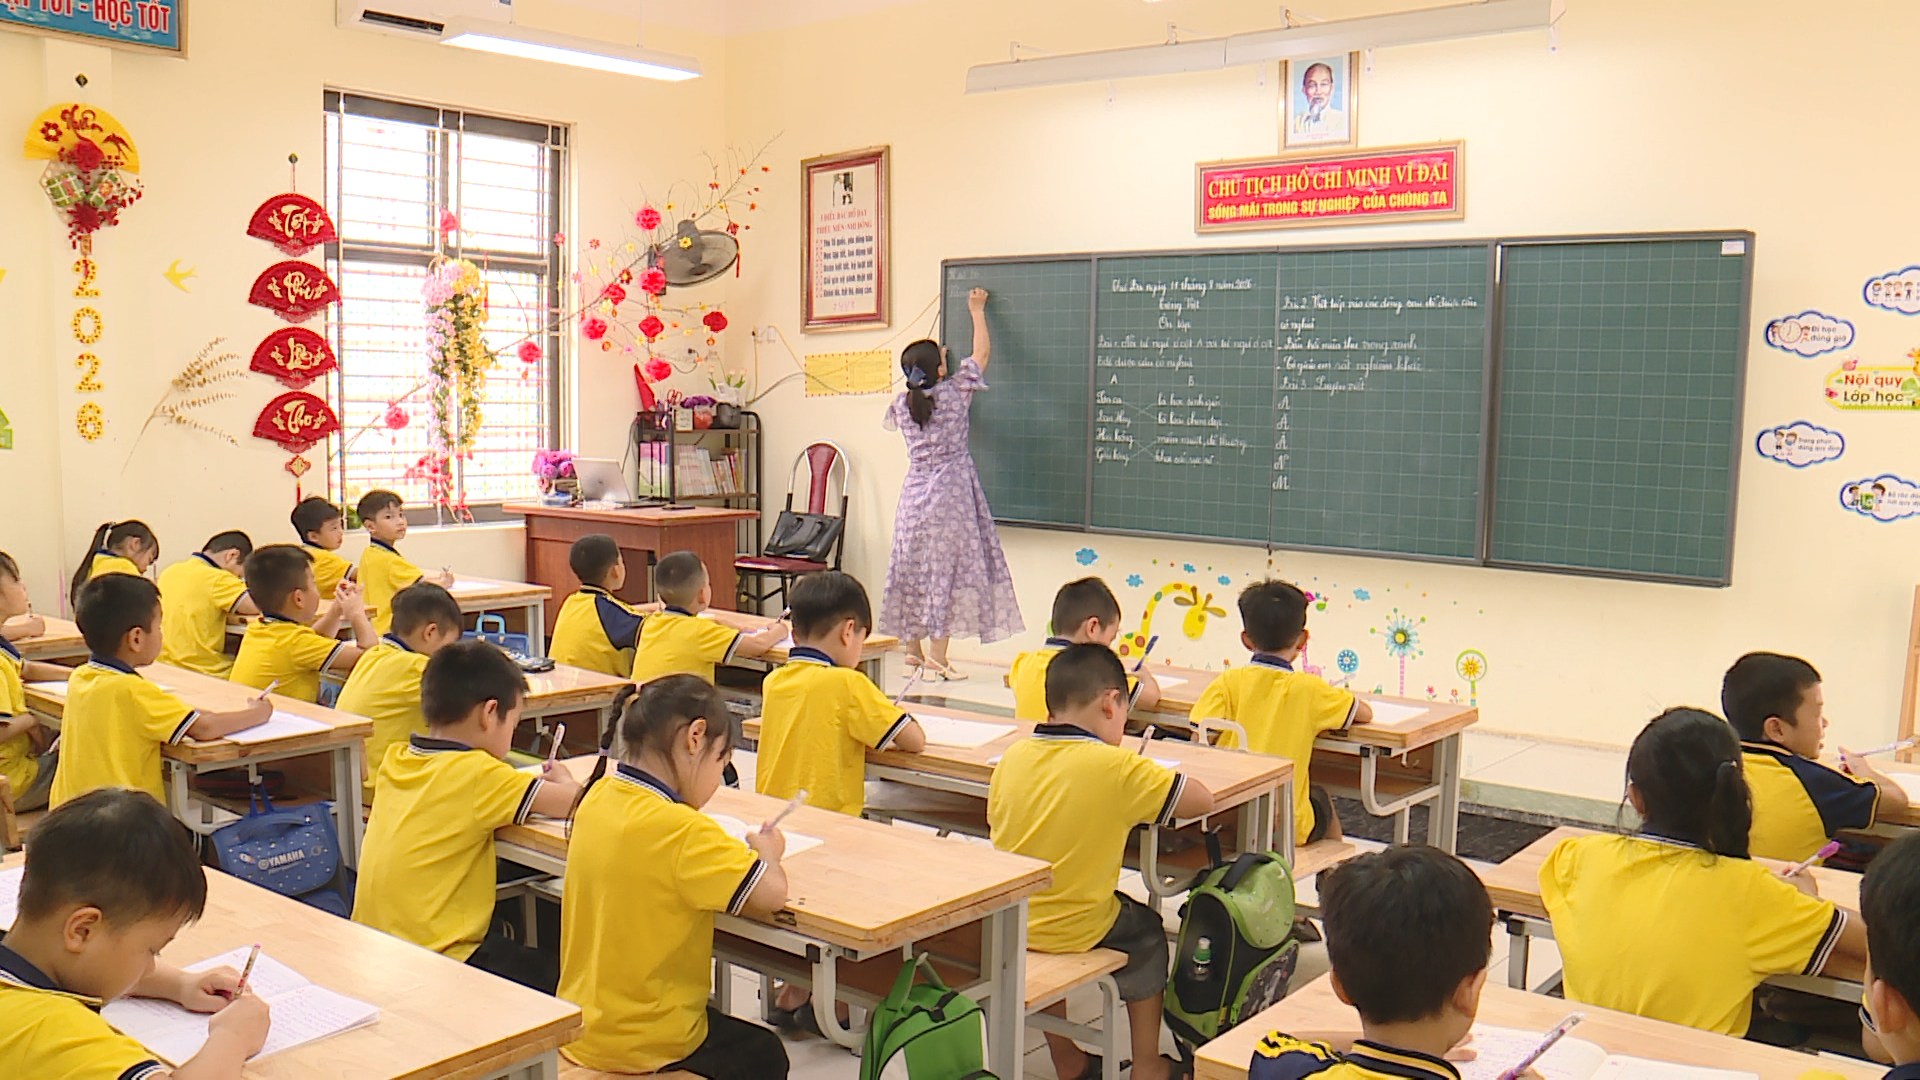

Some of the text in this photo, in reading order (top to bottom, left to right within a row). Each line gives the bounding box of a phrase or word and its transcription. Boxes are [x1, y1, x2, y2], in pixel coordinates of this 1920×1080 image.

[94, 0, 132, 30] HỌC
[137, 0, 171, 33] TỐT
[1245, 175, 1284, 198] TỊCH
[1313, 167, 1343, 190] CHÍ
[1346, 165, 1391, 188] MINH
[1418, 162, 1448, 187] ĐẠI
[1208, 201, 1237, 220] SỐNG
[1263, 201, 1298, 216] TRONG
[1300, 199, 1318, 216] SỰ
[1319, 195, 1360, 214] NGHIỆP
[1363, 190, 1387, 210] CỦA
[1389, 189, 1429, 207] CHÚNG
[1433, 190, 1448, 205] TA
[1110, 373, 1118, 384] A
[1188, 374, 1195, 386] B
[1844, 373, 1903, 388] Nội quy
[1843, 390, 1904, 406] Lớp học
[269, 849, 305, 867] YAMAHA
